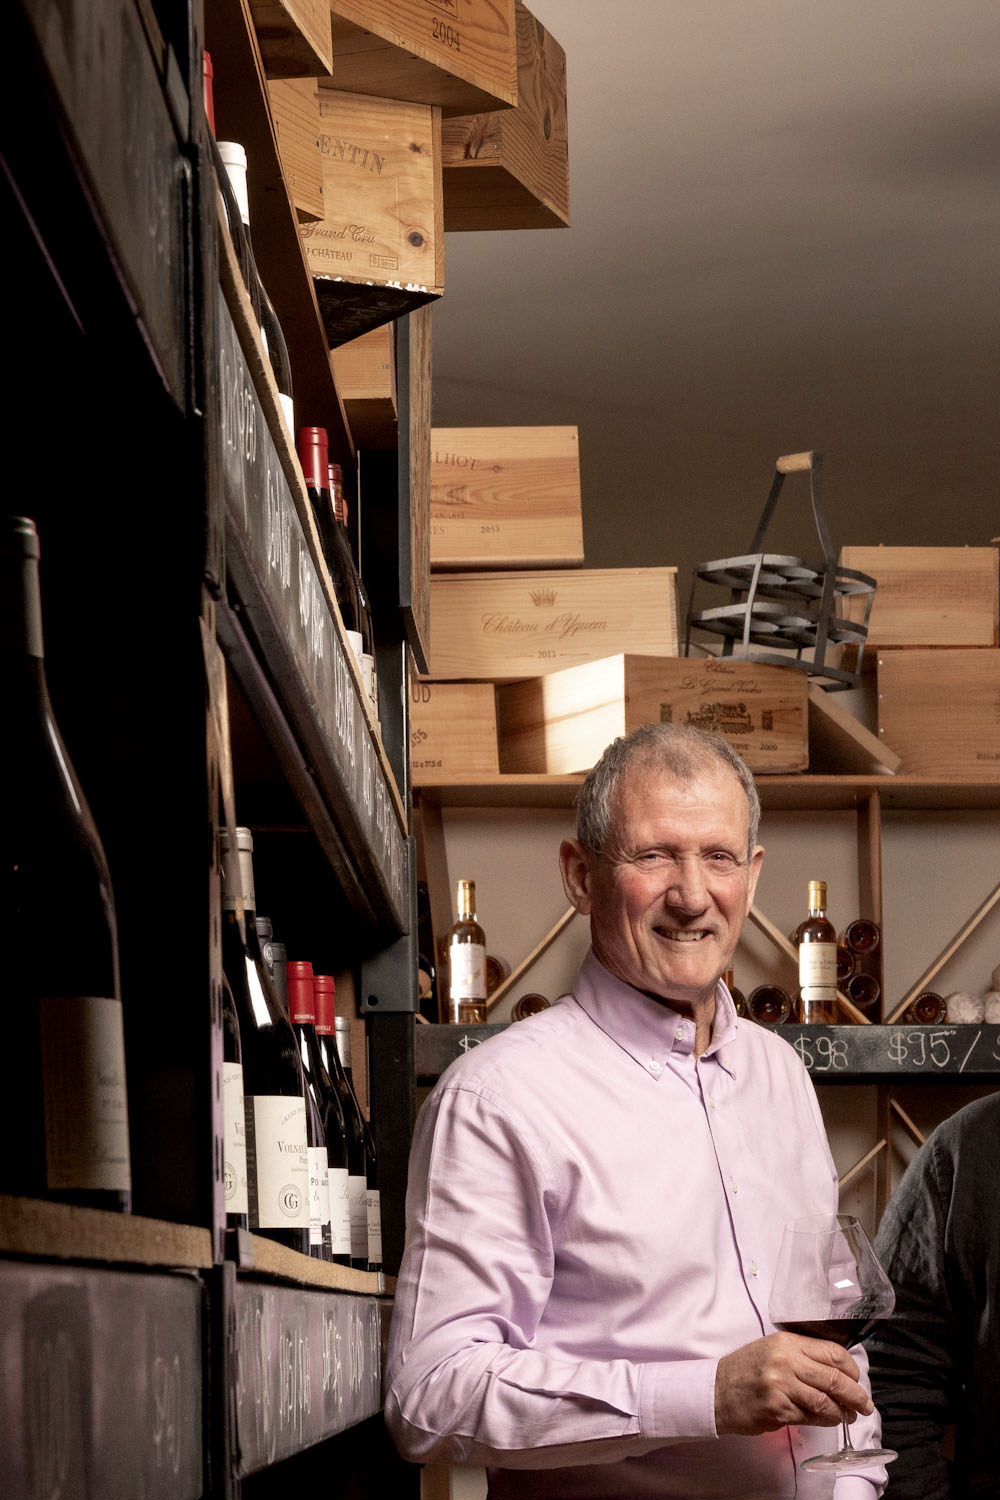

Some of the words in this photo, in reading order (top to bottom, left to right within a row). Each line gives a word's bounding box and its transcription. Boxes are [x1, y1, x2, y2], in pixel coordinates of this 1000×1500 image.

[432, 17, 461, 52] 2004
[347, 223, 377, 245] Cru
[311, 246, 353, 262] CHÂTEAU
[481, 612, 539, 634] Château
[794, 1034, 850, 1071] $98
